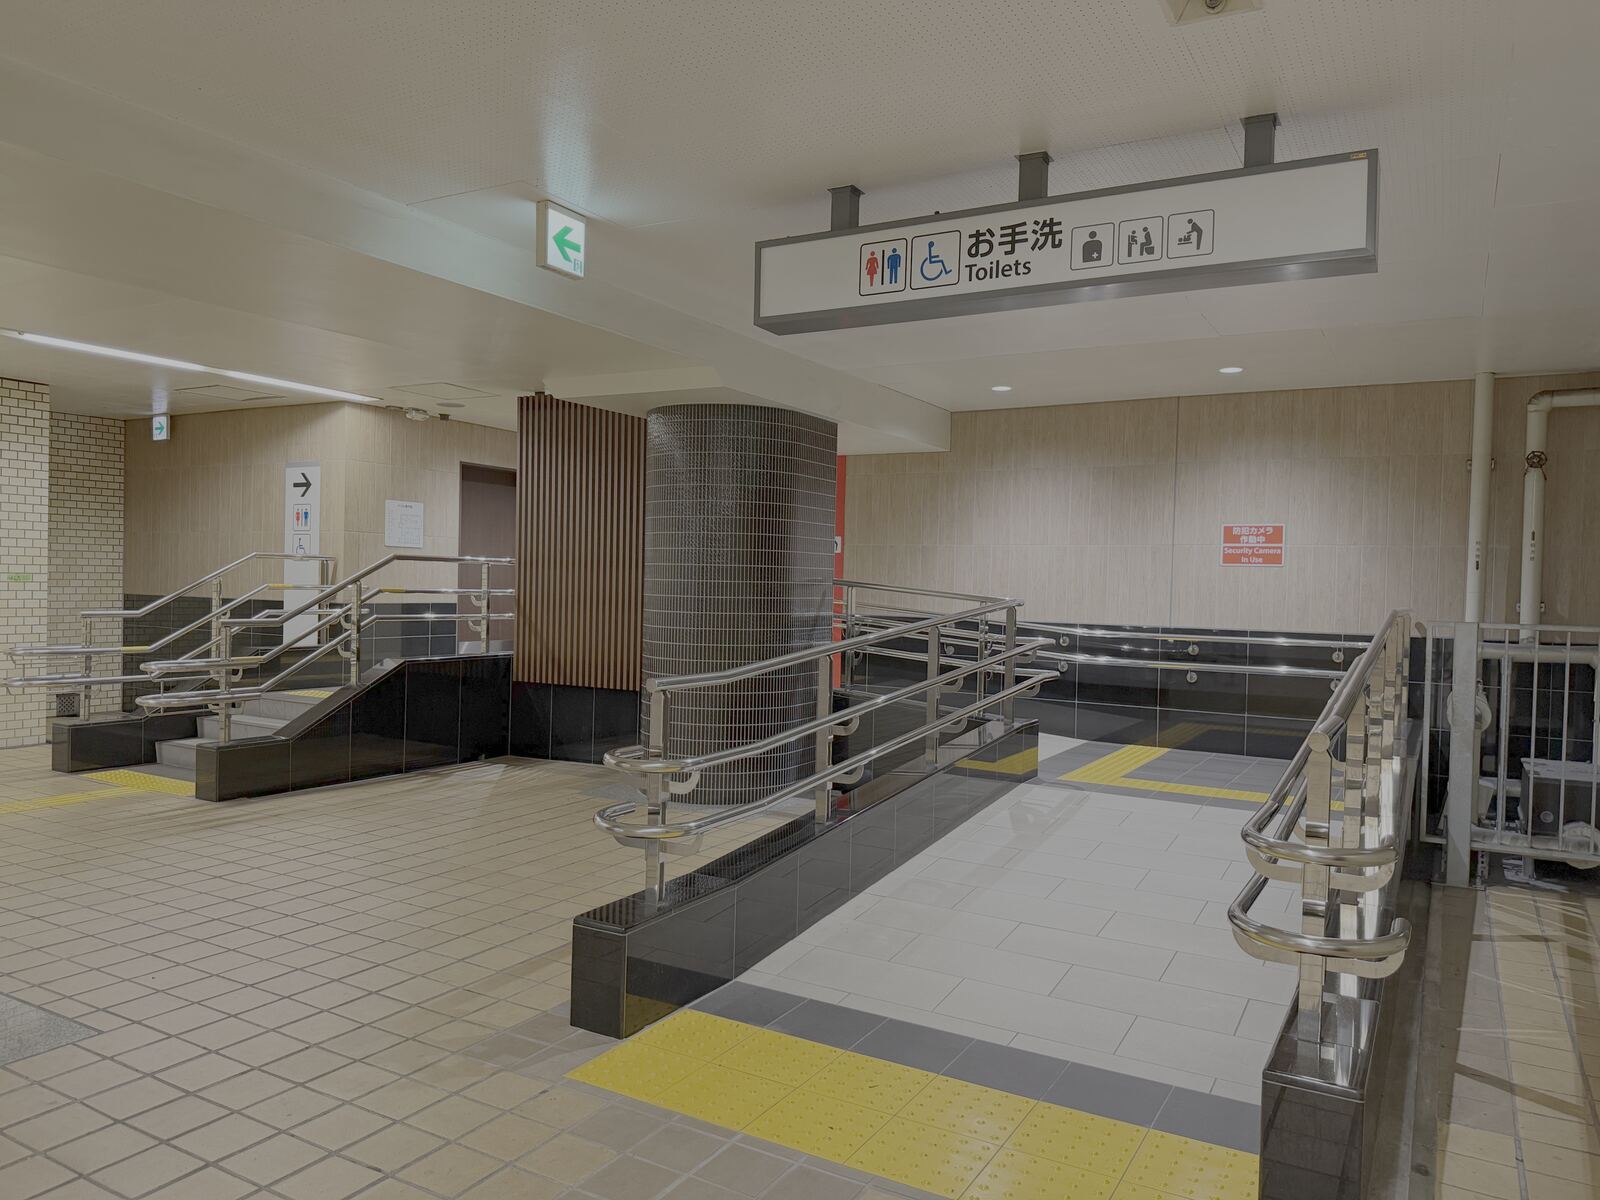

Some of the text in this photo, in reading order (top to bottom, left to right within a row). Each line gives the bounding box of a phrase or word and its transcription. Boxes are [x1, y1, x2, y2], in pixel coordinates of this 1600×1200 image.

[967, 217, 1063, 258] お手洗
[965, 259, 1032, 282] Toilets
[1232, 526, 1273, 535] 防犯カメラ
[1240, 535, 1265, 544] 作動中
[1223, 547, 1252, 555] Security
